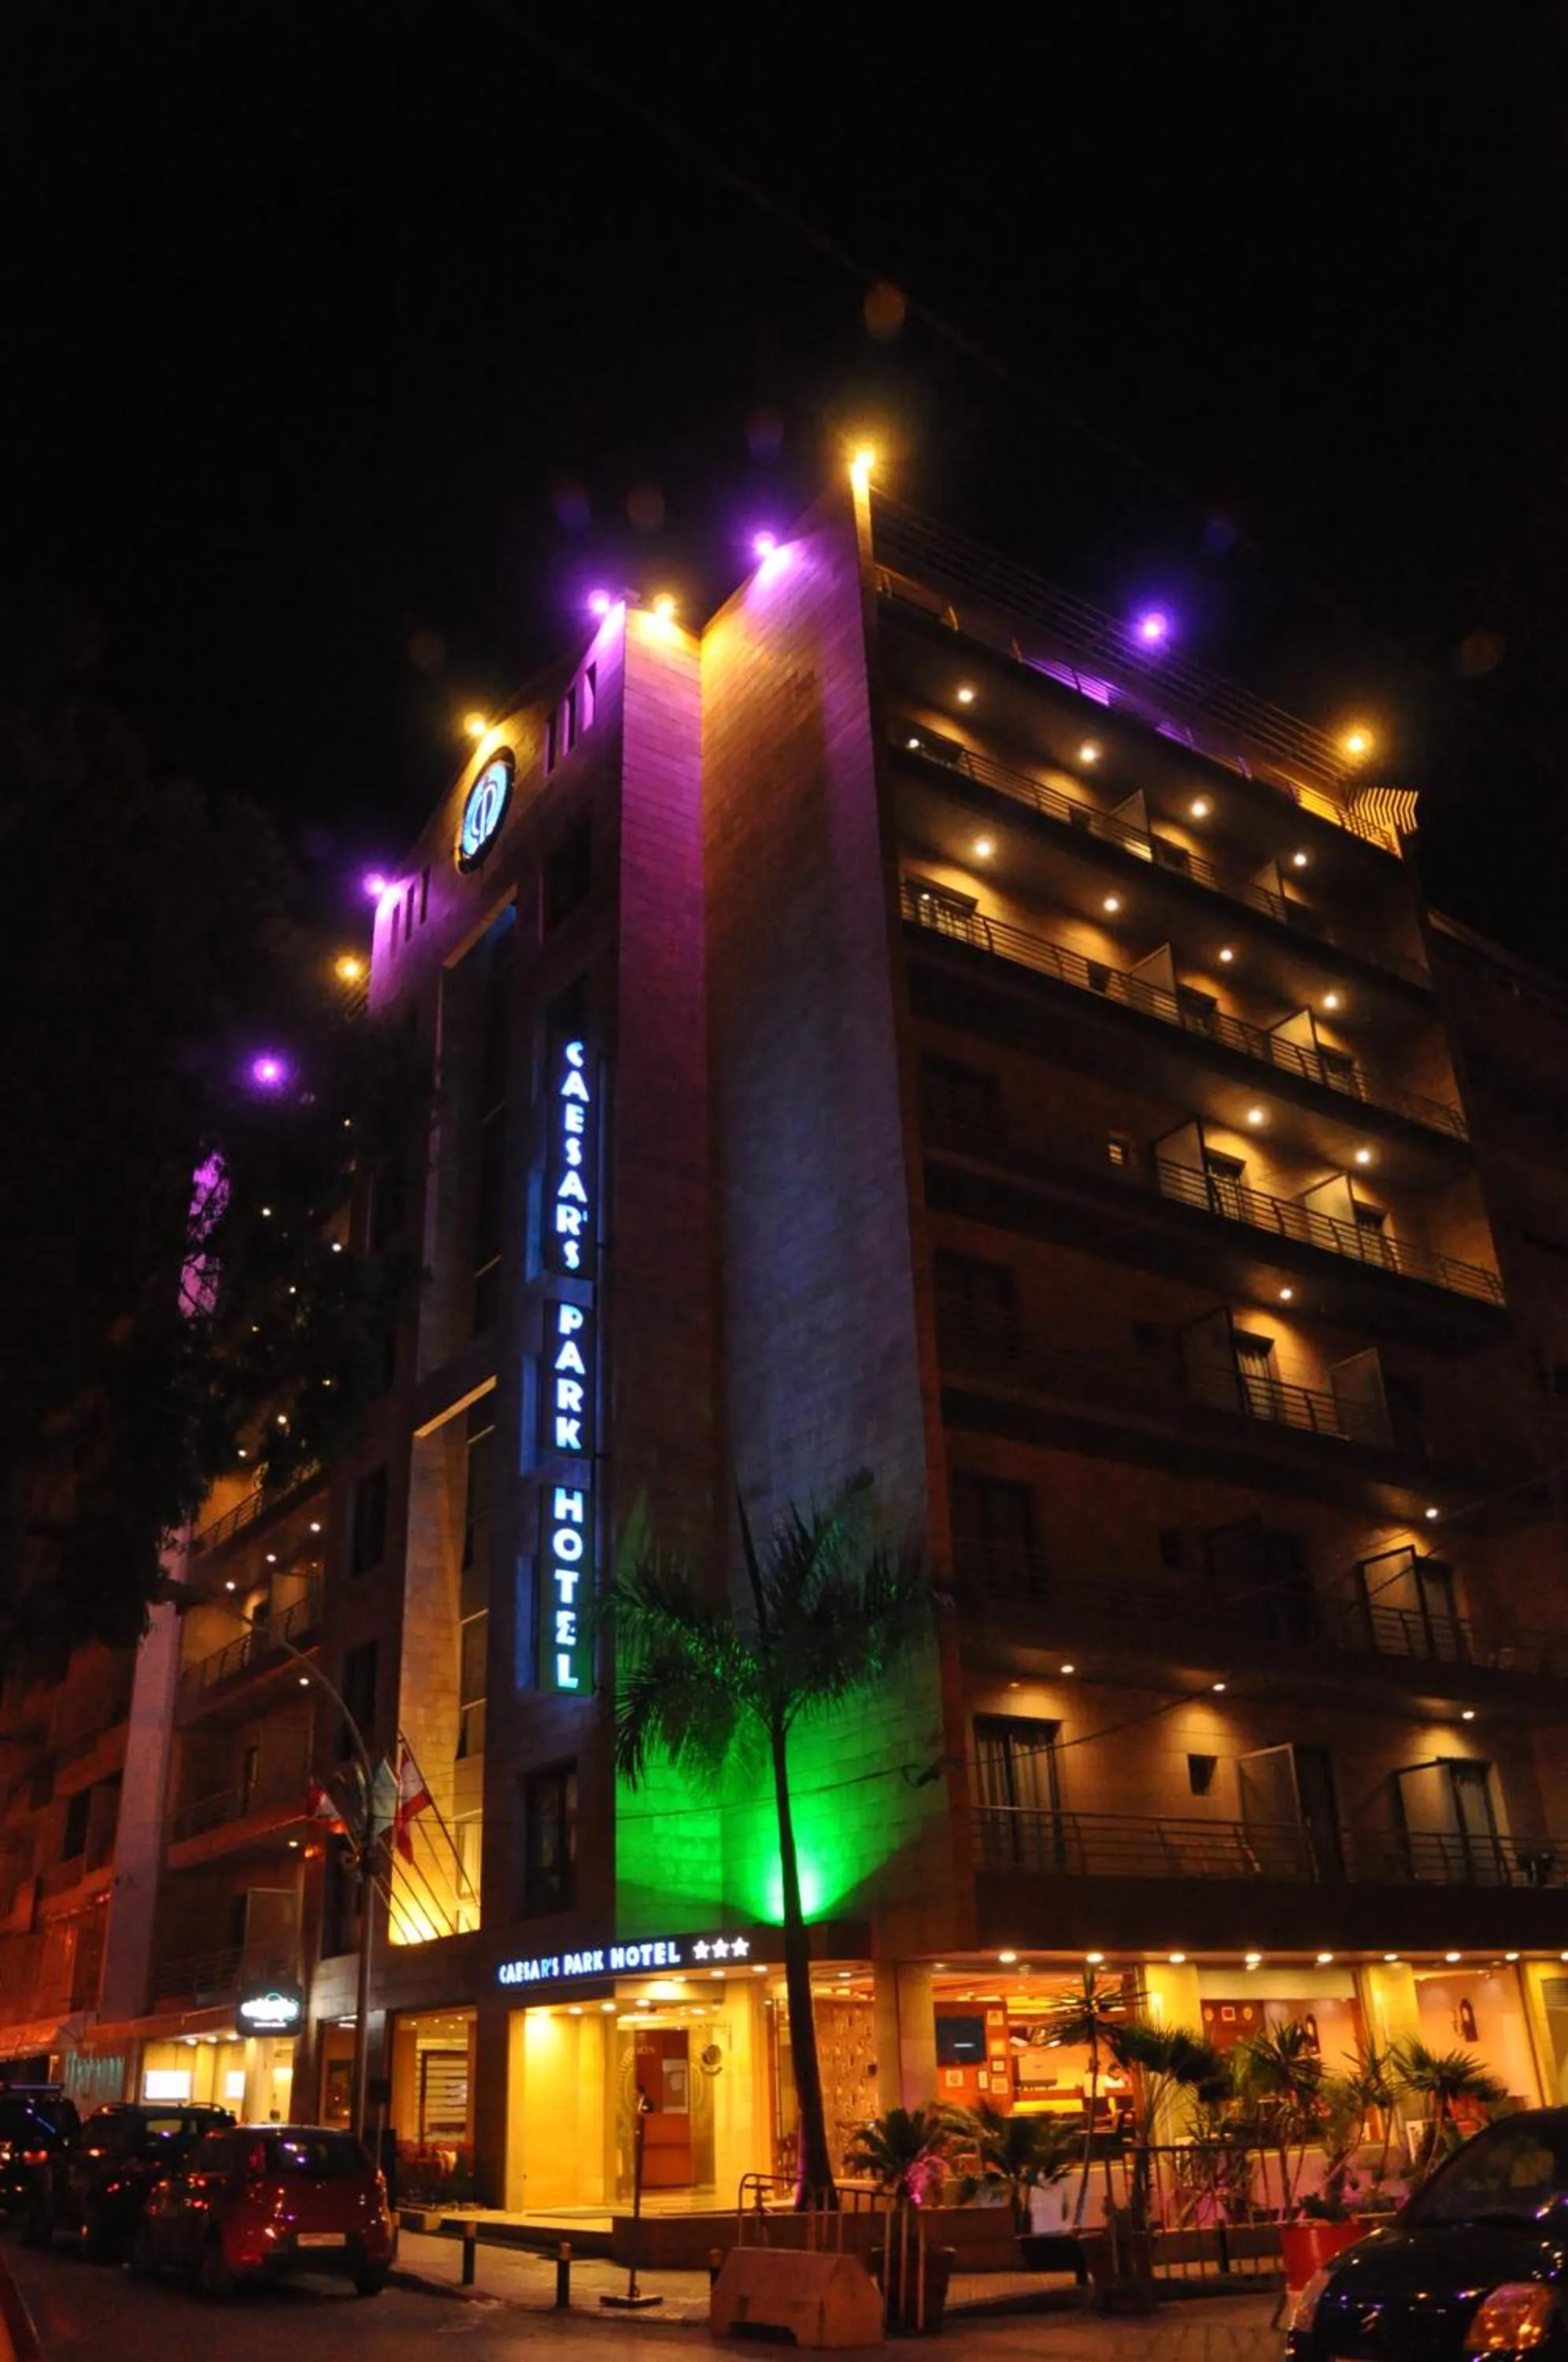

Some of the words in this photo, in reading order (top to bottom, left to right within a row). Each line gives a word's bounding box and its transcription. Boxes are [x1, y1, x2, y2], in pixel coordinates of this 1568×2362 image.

[554, 1303, 586, 1449] PARK
[553, 1486, 583, 1690] HOTEL
[499, 1957, 559, 1984] CAESAR'S
[564, 1950, 605, 1975] PARK
[610, 1942, 681, 1970] HOTEL
